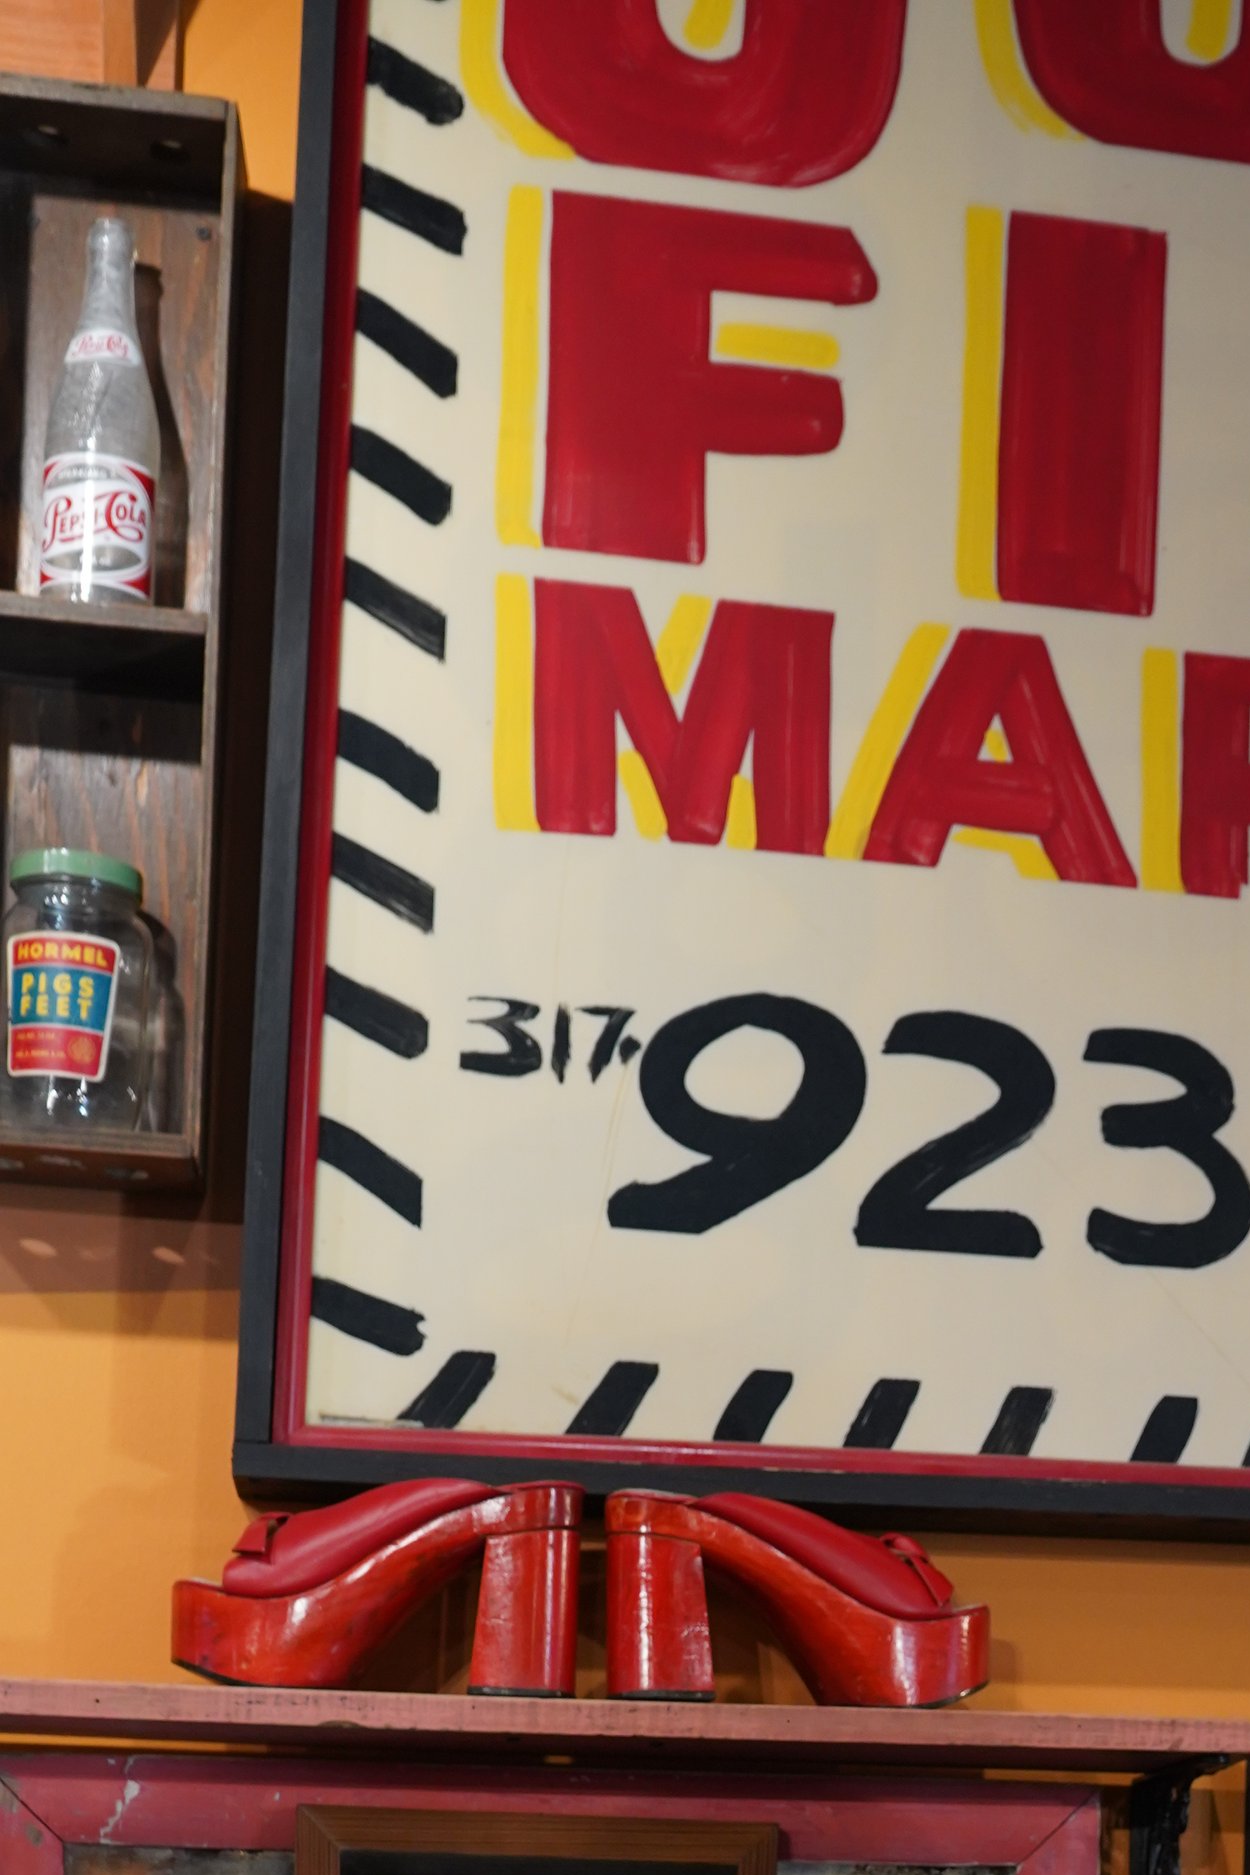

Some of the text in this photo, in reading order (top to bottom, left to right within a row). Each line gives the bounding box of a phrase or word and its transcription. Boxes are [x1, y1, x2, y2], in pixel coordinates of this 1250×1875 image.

[18, 942, 107, 968] HORMEL
[22, 972, 94, 998] PIGS
[20, 994, 92, 1021] FEET
